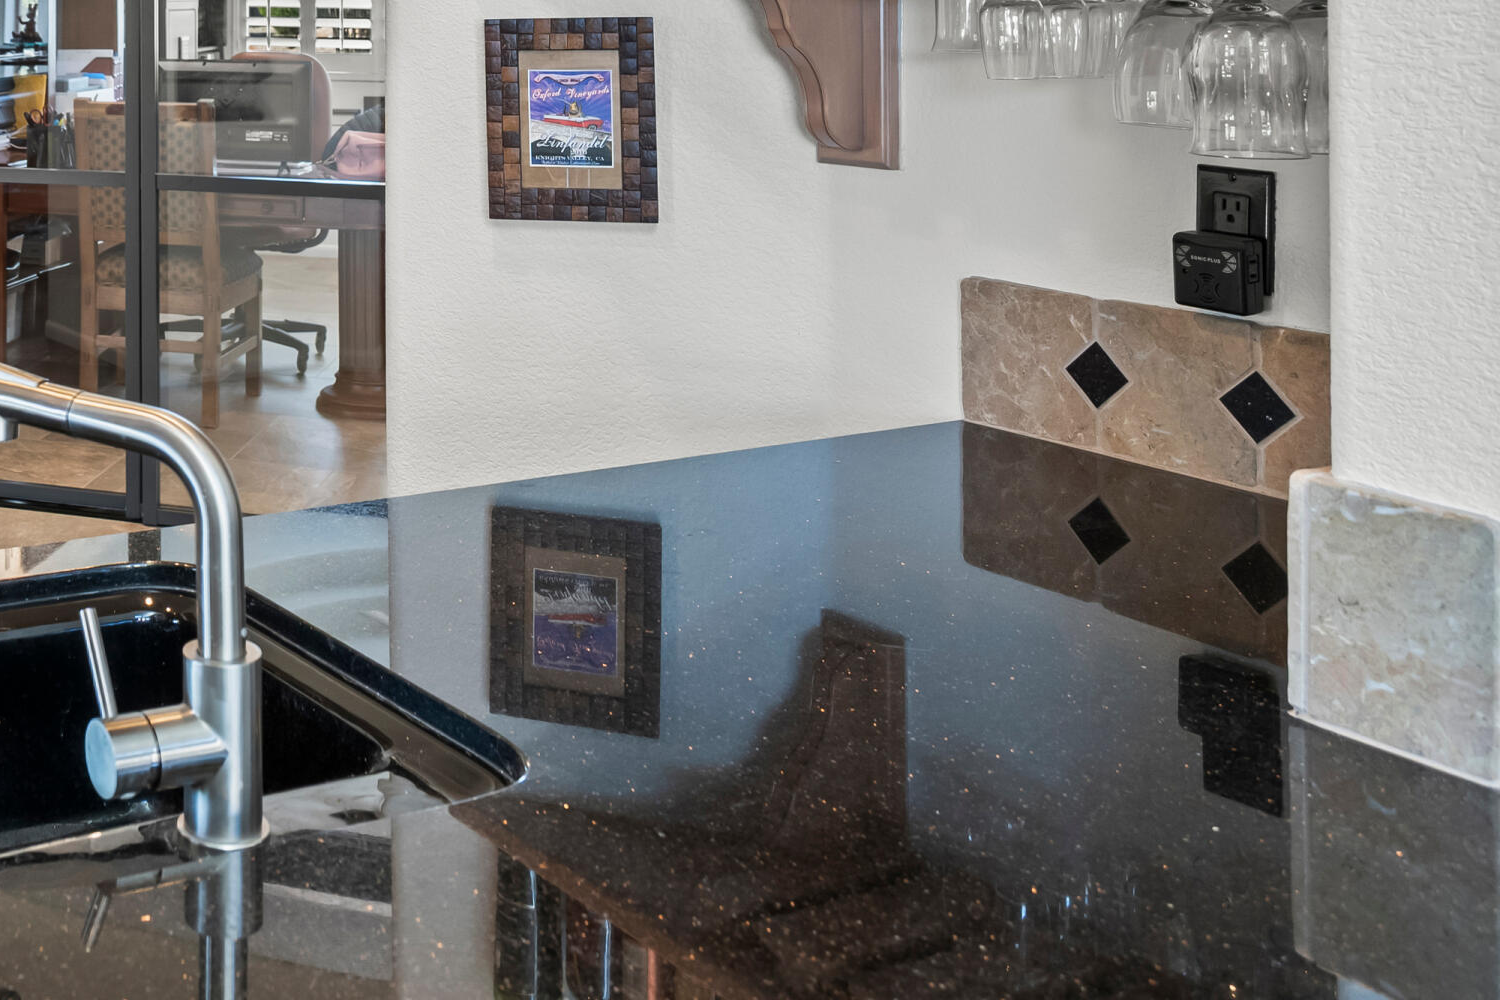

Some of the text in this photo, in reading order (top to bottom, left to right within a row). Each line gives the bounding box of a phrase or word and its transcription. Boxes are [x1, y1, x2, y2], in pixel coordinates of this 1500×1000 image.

[532, 85, 610, 102] Oxford Vineyards
[536, 133, 609, 153] Zinfandel
